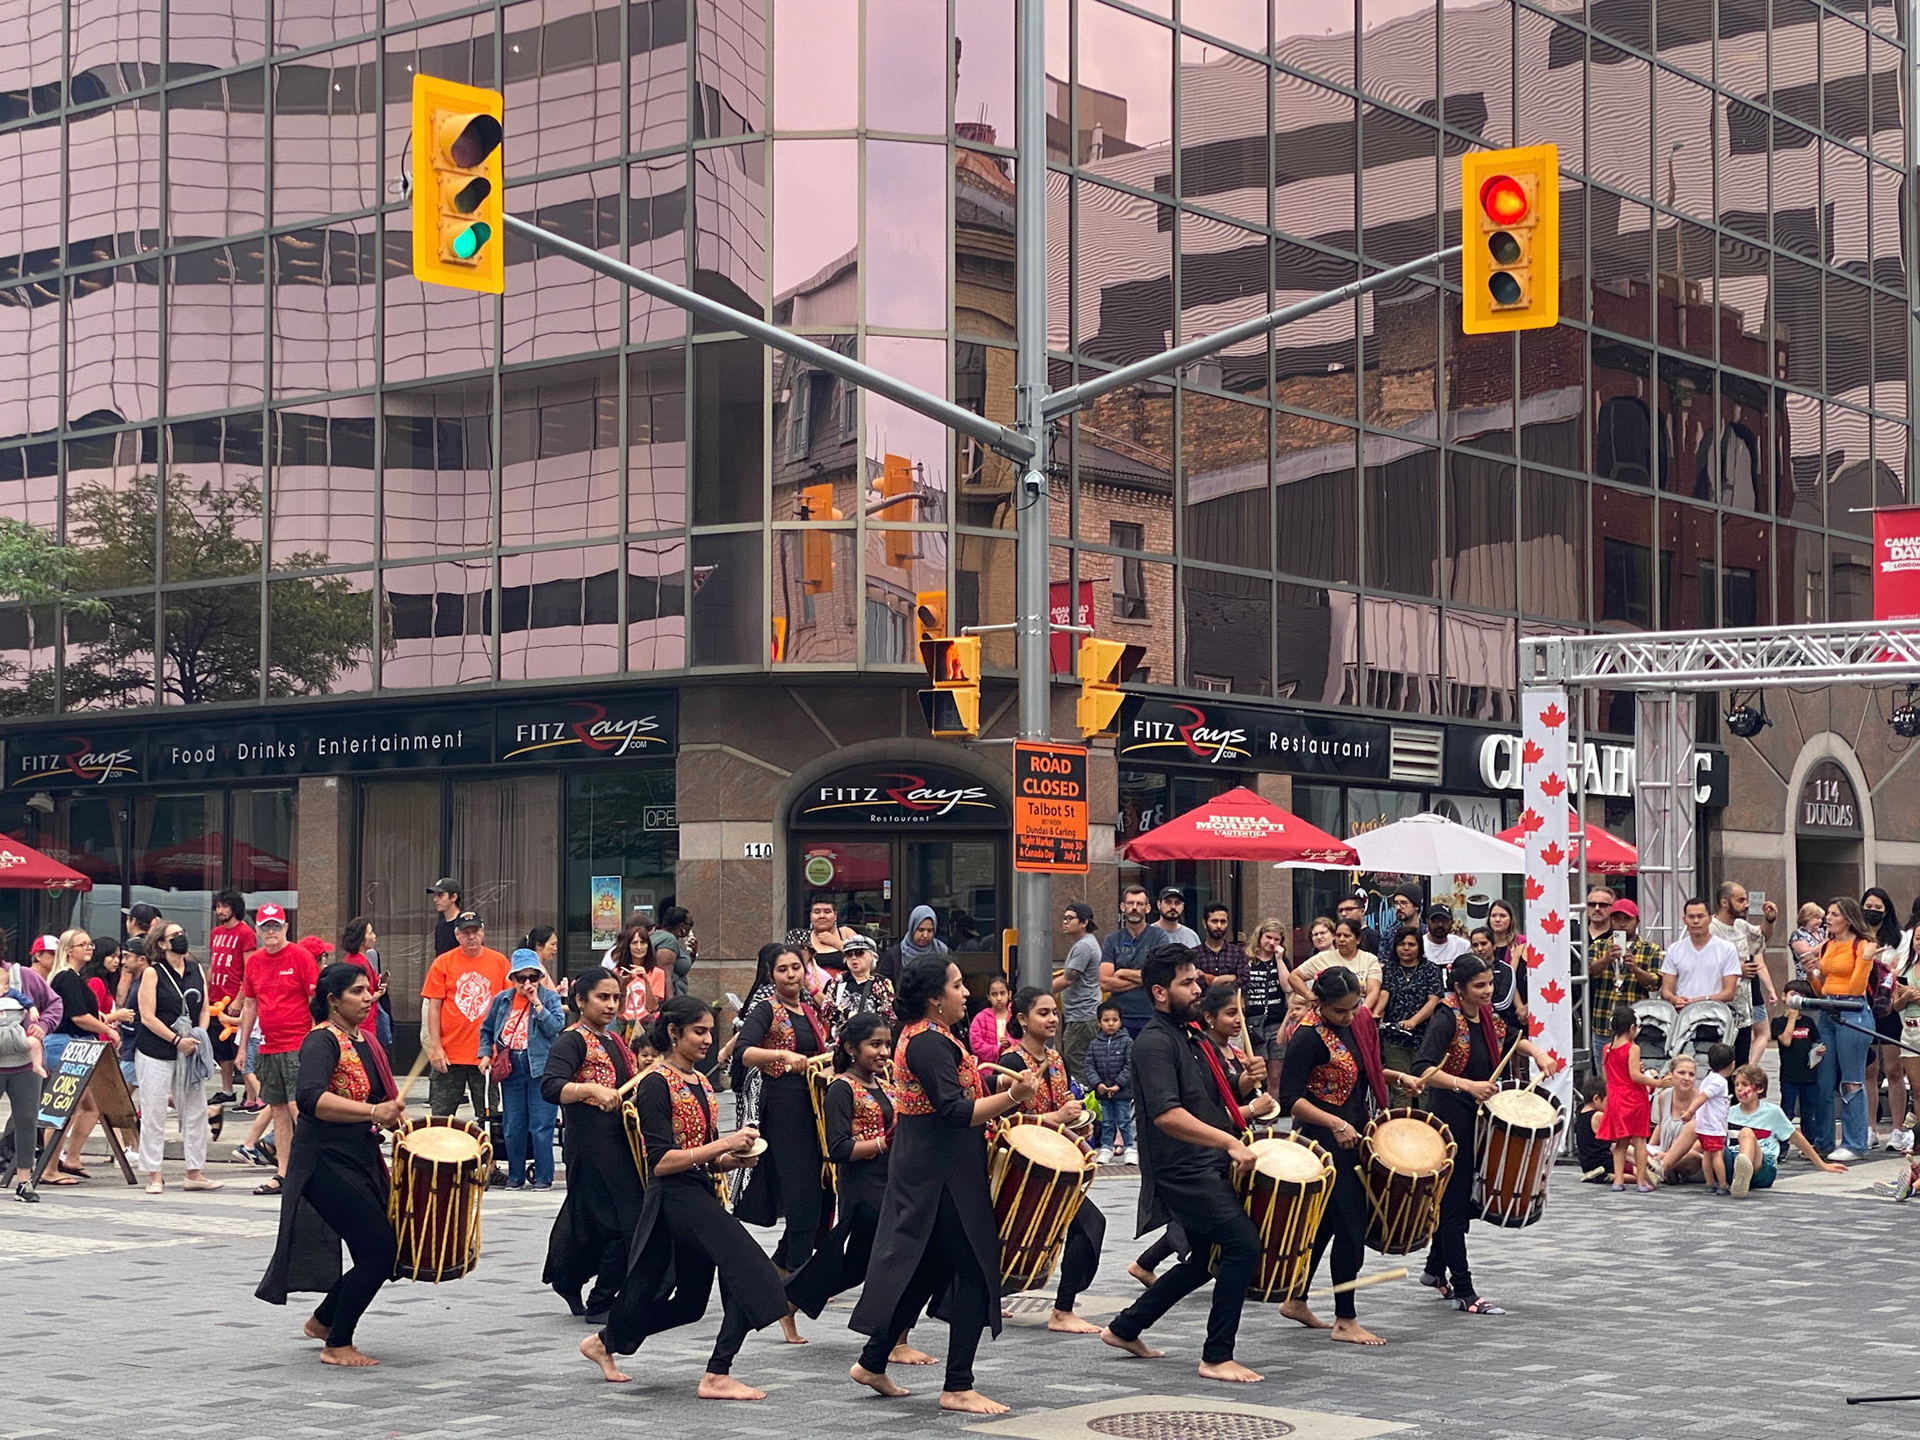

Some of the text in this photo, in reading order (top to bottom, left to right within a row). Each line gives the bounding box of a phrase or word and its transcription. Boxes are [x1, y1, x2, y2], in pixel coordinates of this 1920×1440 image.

[1891, 547, 1920, 560] DAY
[516, 702, 659, 756] FITZ Rays
[1134, 704, 1247, 763] FITZ Rays
[172, 729, 462, 764] Food Drinks Entertainment
[1269, 731, 1370, 758] Restaurant
[22, 736, 133, 784] FITZ Rays
[1030, 756, 1072, 775] ROAD
[820, 773, 987, 816] FITZ Rays
[1023, 777, 1080, 797] CLOSED
[1815, 780, 1839, 804] 114
[646, 810, 679, 827] OPE
[870, 814, 930, 822] Restaurant
[1027, 802, 1075, 818] Talbot St
[1805, 802, 1854, 827] DUNDAS
[1195, 821, 1285, 832] MORETTI
[1209, 815, 1270, 824] BIRRA
[1026, 825, 1076, 839] Dundas & Carling
[745, 843, 772, 858] 110
[1024, 847, 1044, 858] Canada
[1044, 849, 1055, 860] Day
[1060, 839, 1074, 850] June
[1063, 850, 1081, 862] July 2
[630, 893, 652, 905] ATM
[52, 1075, 80, 1096] CANS
[41, 1093, 75, 1112] TO GO!
